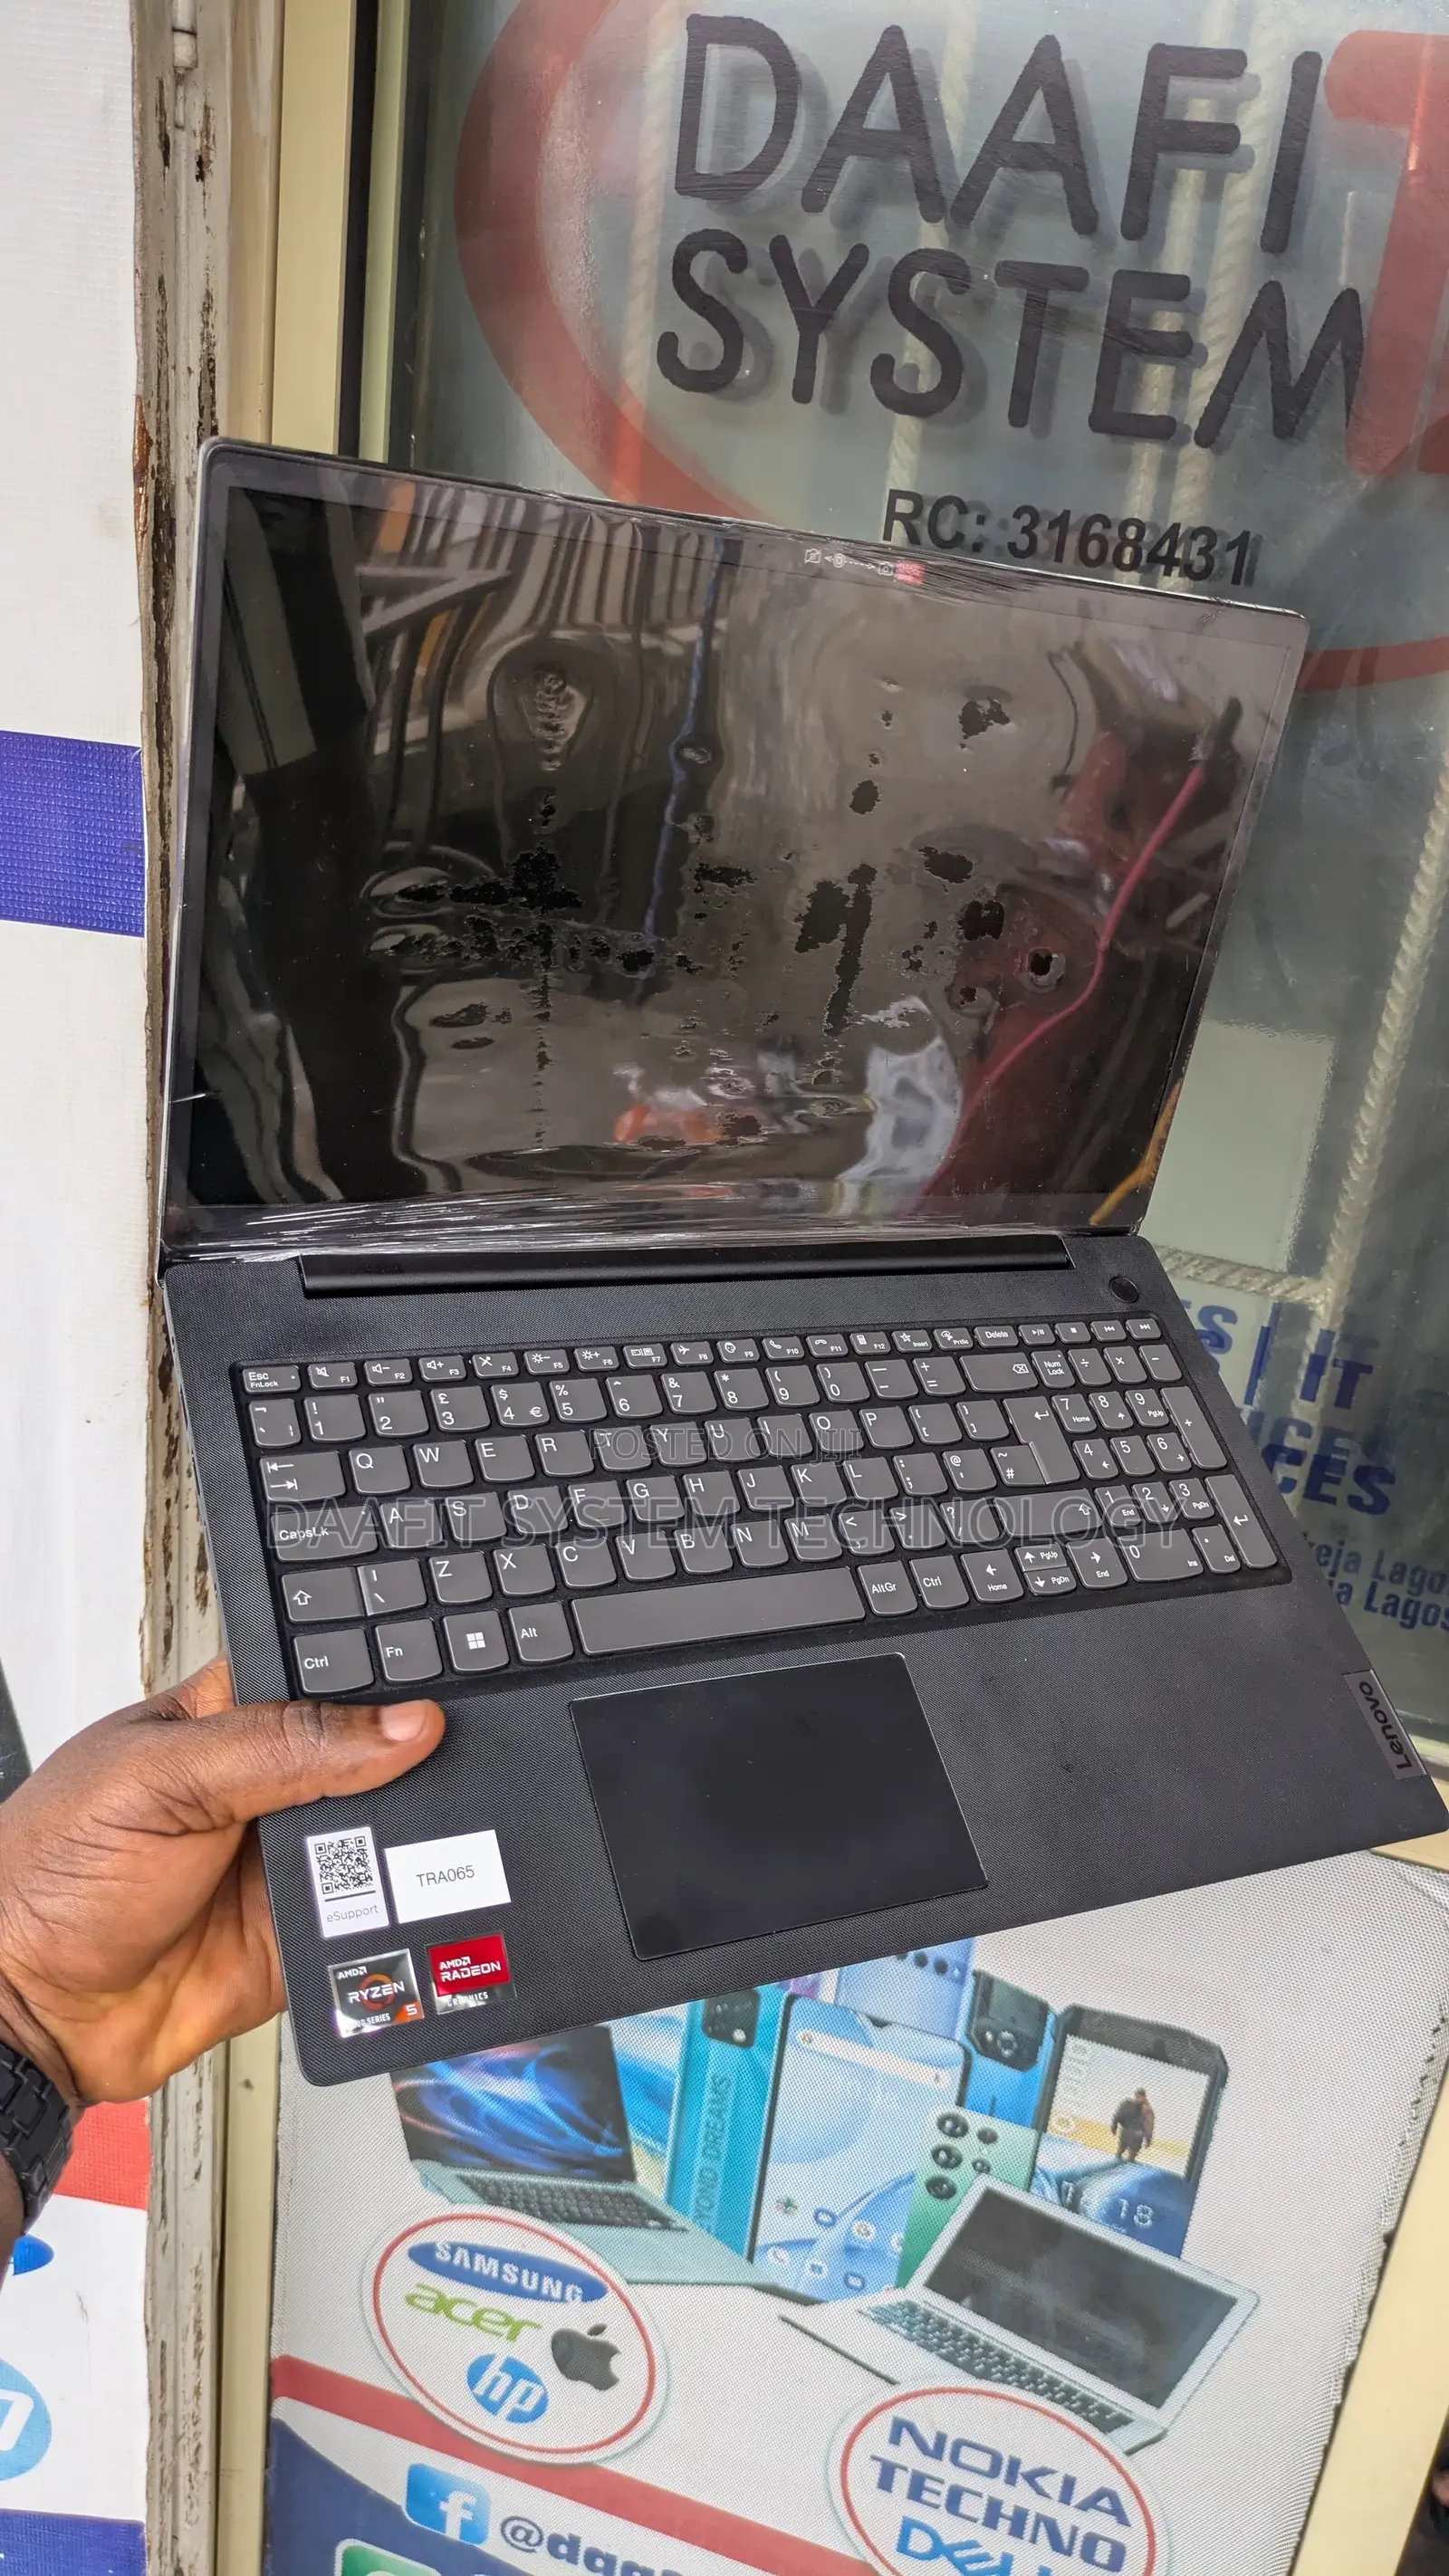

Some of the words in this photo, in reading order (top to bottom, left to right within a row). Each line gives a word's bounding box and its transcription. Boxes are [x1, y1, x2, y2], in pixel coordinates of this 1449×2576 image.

[656, 228, 1363, 449] SYSTEM
[883, 489, 985, 552] RC:
[1008, 505, 1252, 586] 3168431
[984, 1330, 1009, 1339] Delete
[248, 1372, 270, 1382] Esc
[1047, 1367, 1065, 1375] Lock
[250, 1380, 279, 1388] FnLock
[555, 1384, 569, 1396] %
[668, 1378, 680, 1389] &
[830, 1384, 840, 1397] 0
[438, 1393, 450, 1404] £
[498, 1388, 509, 1401] $
[672, 1394, 684, 1408] 7
[727, 1391, 738, 1404] 8
[779, 1387, 790, 1401] 9
[1134, 1393, 1146, 1405] 9
[619, 1398, 630, 1412] 6
[1060, 1398, 1070, 1411] 7
[1098, 1395, 1109, 1408] 8
[504, 1406, 515, 1420] 4
[529, 1406, 543, 1417] €
[561, 1403, 574, 1416] 5
[1147, 1410, 1165, 1418] PgUp
[379, 1416, 393, 1431] 2
[442, 1412, 455, 1426] 3
[816, 1416, 831, 1431] O
[865, 1412, 878, 1426] P
[314, 1421, 324, 1435] 1
[657, 1428, 668, 1442] Y
[710, 1424, 724, 1439] U
[541, 1438, 558, 1452] R
[600, 1432, 612, 1447] T
[1119, 1440, 1131, 1453] 5
[1156, 1437, 1168, 1451] 6
[419, 1447, 440, 1463] W
[480, 1442, 496, 1458] E
[1083, 1443, 1094, 1456] 4
[356, 1452, 374, 1470] Q
[950, 1455, 962, 1467] @
[797, 1469, 812, 1483] K
[849, 1464, 862, 1479] L
[1005, 1468, 1015, 1480] #
[688, 1478, 705, 1493] H
[746, 1473, 756, 1488] J
[1261, 1443, 1396, 1516] CES
[573, 1489, 586, 1503] F
[633, 1483, 650, 1499] G
[1105, 1490, 1115, 1504] 1
[1142, 1487, 1155, 1500] 2
[1178, 1483, 1191, 1497] 3
[513, 1494, 529, 1509] D
[1192, 1501, 1209, 1509] PgDn
[389, 1508, 405, 1524] A
[453, 1501, 467, 1517] S
[946, 1507, 955, 1519] ?
[1121, 1508, 1135, 1517] End
[279, 1527, 330, 1540] CapsLk
[736, 1527, 753, 1543] N
[791, 1522, 810, 1537] M
[621, 1539, 636, 1556] V
[680, 1534, 696, 1549] B
[562, 1546, 579, 1562] C
[1040, 1551, 1059, 1561] PgUp
[1129, 1545, 1141, 1558] 0
[499, 1553, 517, 1570] X
[1187, 1559, 1199, 1567] Ins
[1223, 1555, 1236, 1563] Del
[436, 1560, 453, 1577] Z
[1096, 1570, 1109, 1579] End
[923, 1576, 943, 1588] Ctrl
[1051, 1576, 1070, 1585] PgDn
[871, 1583, 897, 1595] AltGr
[987, 1583, 1008, 1593] Home
[520, 1627, 538, 1639] Alt
[385, 1647, 404, 1659] Fn
[303, 1656, 330, 1670] Ctrl
[1359, 1681, 1412, 1769] Lenovo
[416, 1864, 475, 1887] TRA065
[326, 1904, 379, 1923] eSupport
[439, 1960, 502, 1983] RADEON
[348, 1980, 406, 2005] RYZEN
[405, 2004, 417, 2016] 5
[367, 2012, 391, 2025] SERIES
[434, 2241, 584, 2304] SAMSUNG
[404, 2282, 542, 2342] acer
[471, 2354, 545, 2421] hp
[888, 2415, 1132, 2528] NOKIA
[869, 2454, 1127, 2574] TECHNO
